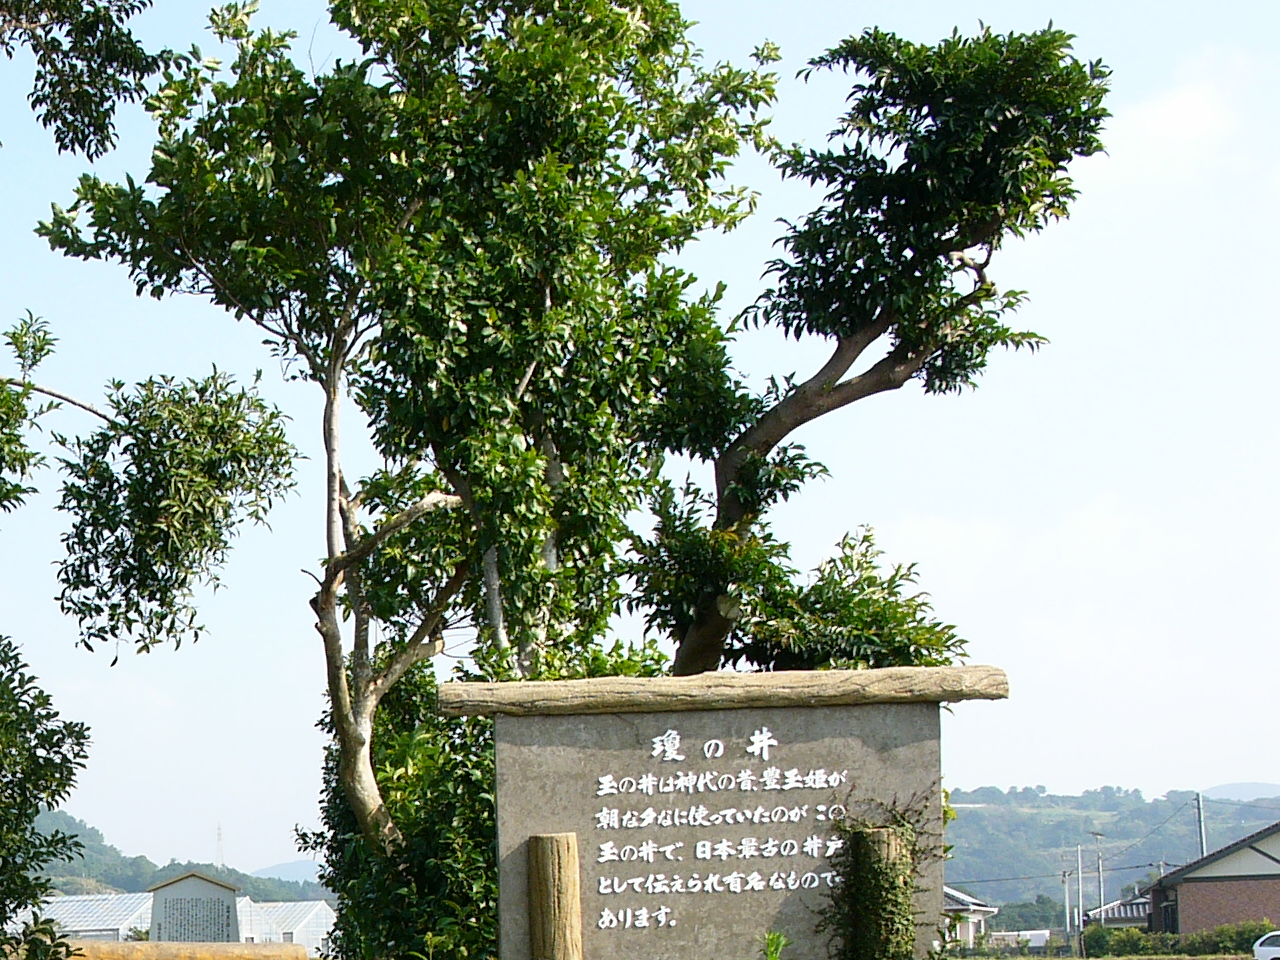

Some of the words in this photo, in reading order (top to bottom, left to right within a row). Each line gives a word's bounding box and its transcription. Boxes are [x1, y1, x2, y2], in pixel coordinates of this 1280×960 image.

[651, 726, 778, 761] 瓊の井
[597, 905, 676, 930] あります。
